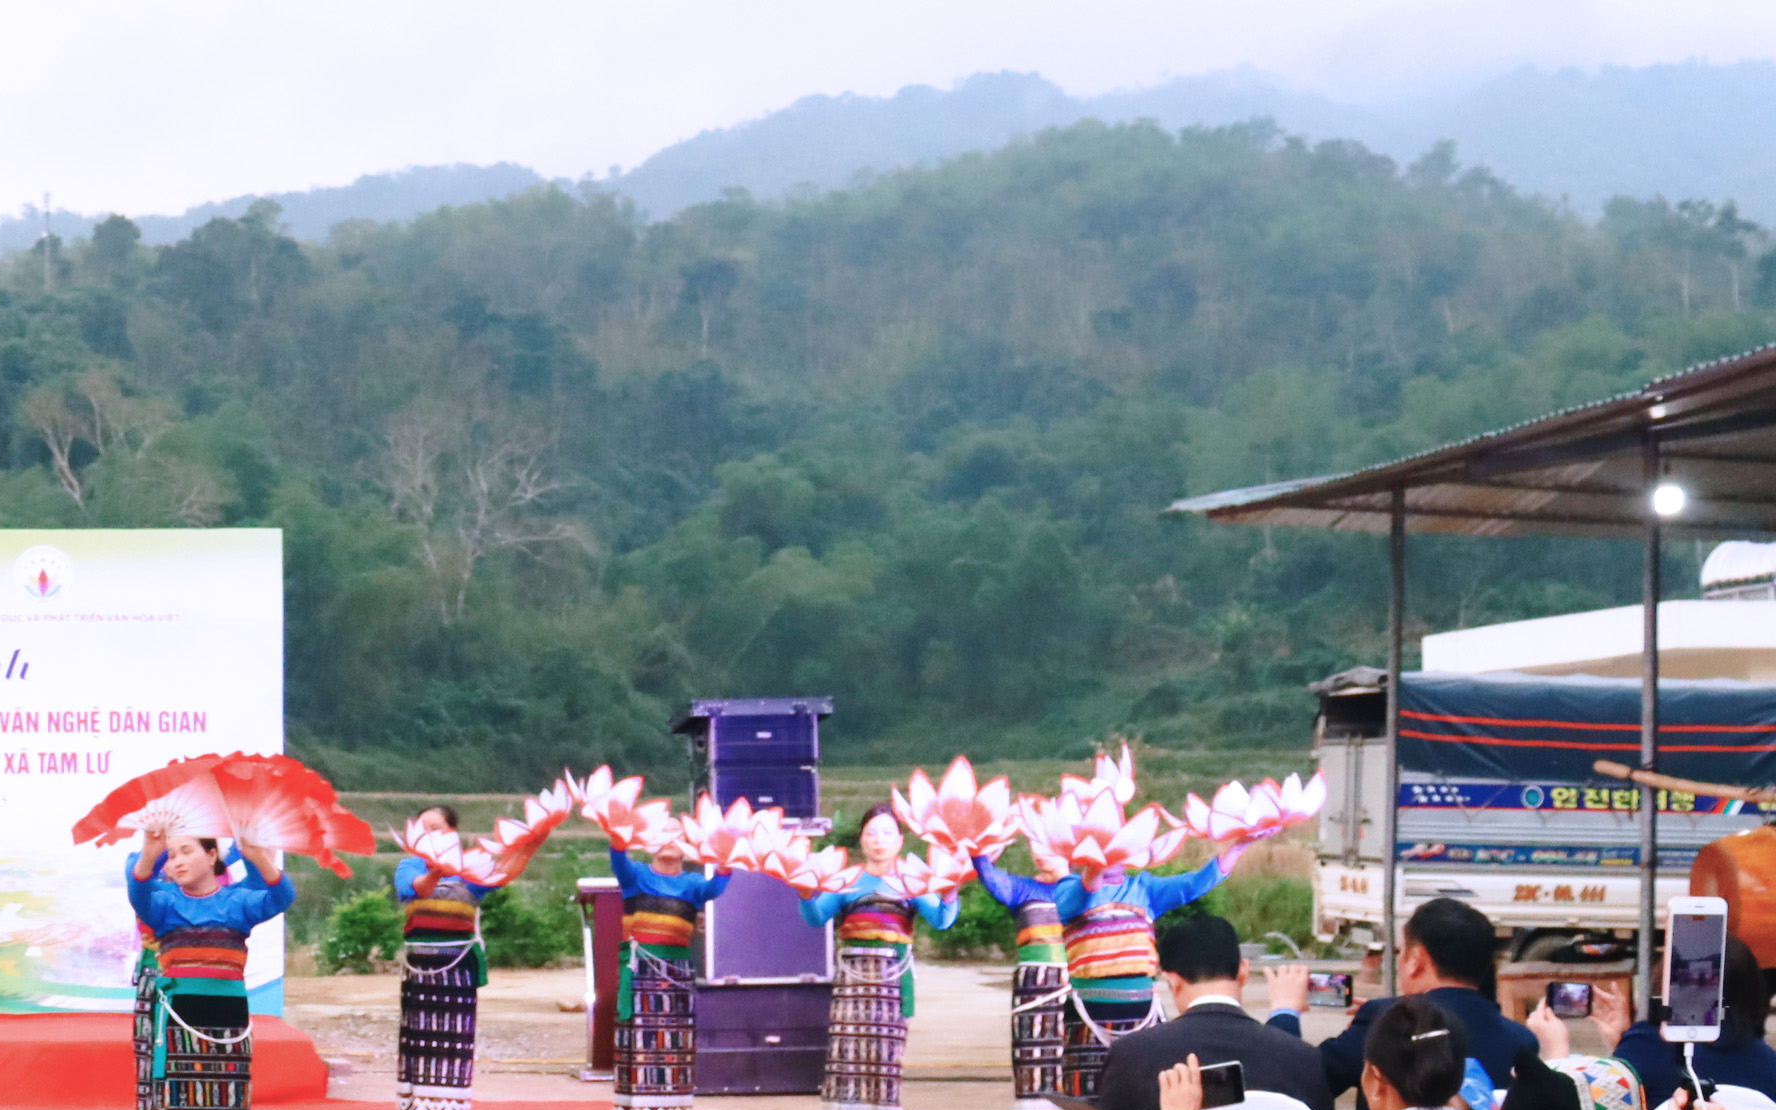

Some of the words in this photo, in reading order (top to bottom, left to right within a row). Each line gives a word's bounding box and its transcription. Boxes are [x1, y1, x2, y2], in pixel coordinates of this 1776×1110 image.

[0, 707, 39, 733] VĂN
[47, 706, 101, 739] NGHỆ
[109, 706, 151, 733] DÂN
[158, 711, 207, 733] GIAN
[4, 748, 30, 774] XÃ
[38, 752, 78, 774] TAM
[86, 750, 112, 774] LƯ
